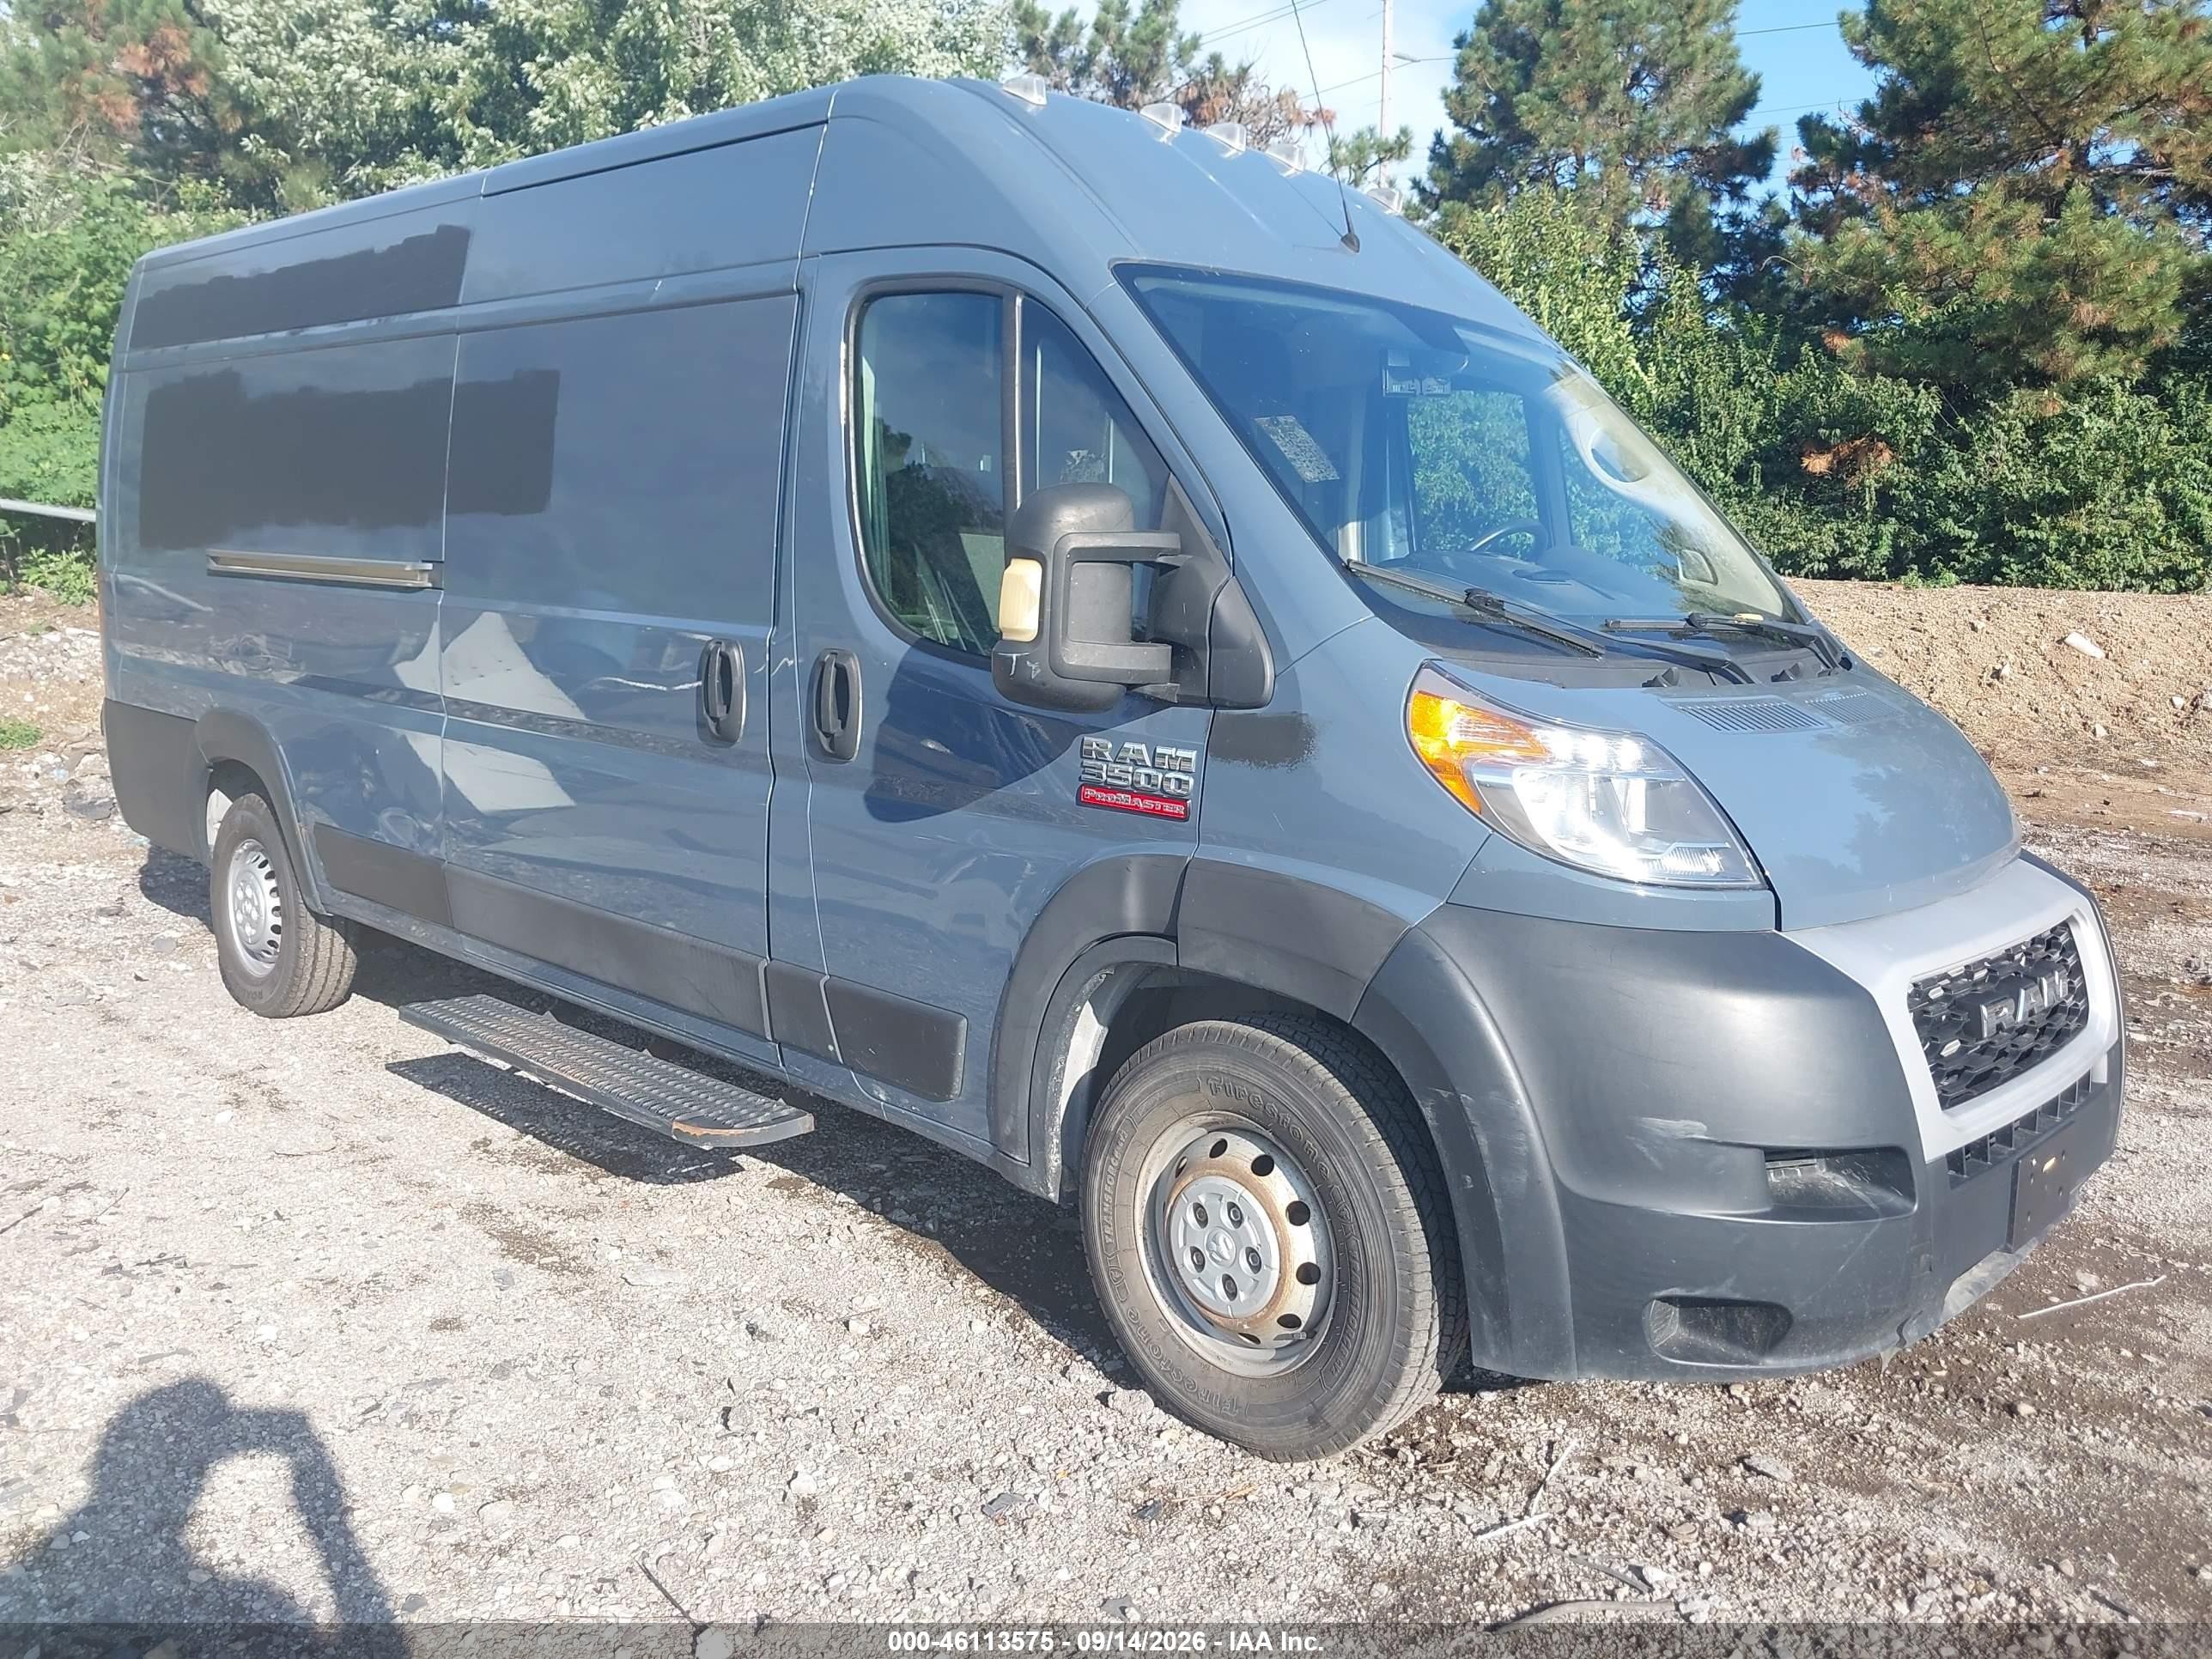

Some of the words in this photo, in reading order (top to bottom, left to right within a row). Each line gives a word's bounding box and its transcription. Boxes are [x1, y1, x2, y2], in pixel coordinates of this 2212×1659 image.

[1079, 759, 1194, 797] 3500
[1081, 736, 1197, 773] RAM
[1980, 969, 2069, 1038] RAM
[1207, 1077, 1330, 1181] Firestone
[1103, 1149, 1122, 1244] TRANSFORCE
[1127, 1306, 1239, 1417] Firestone
